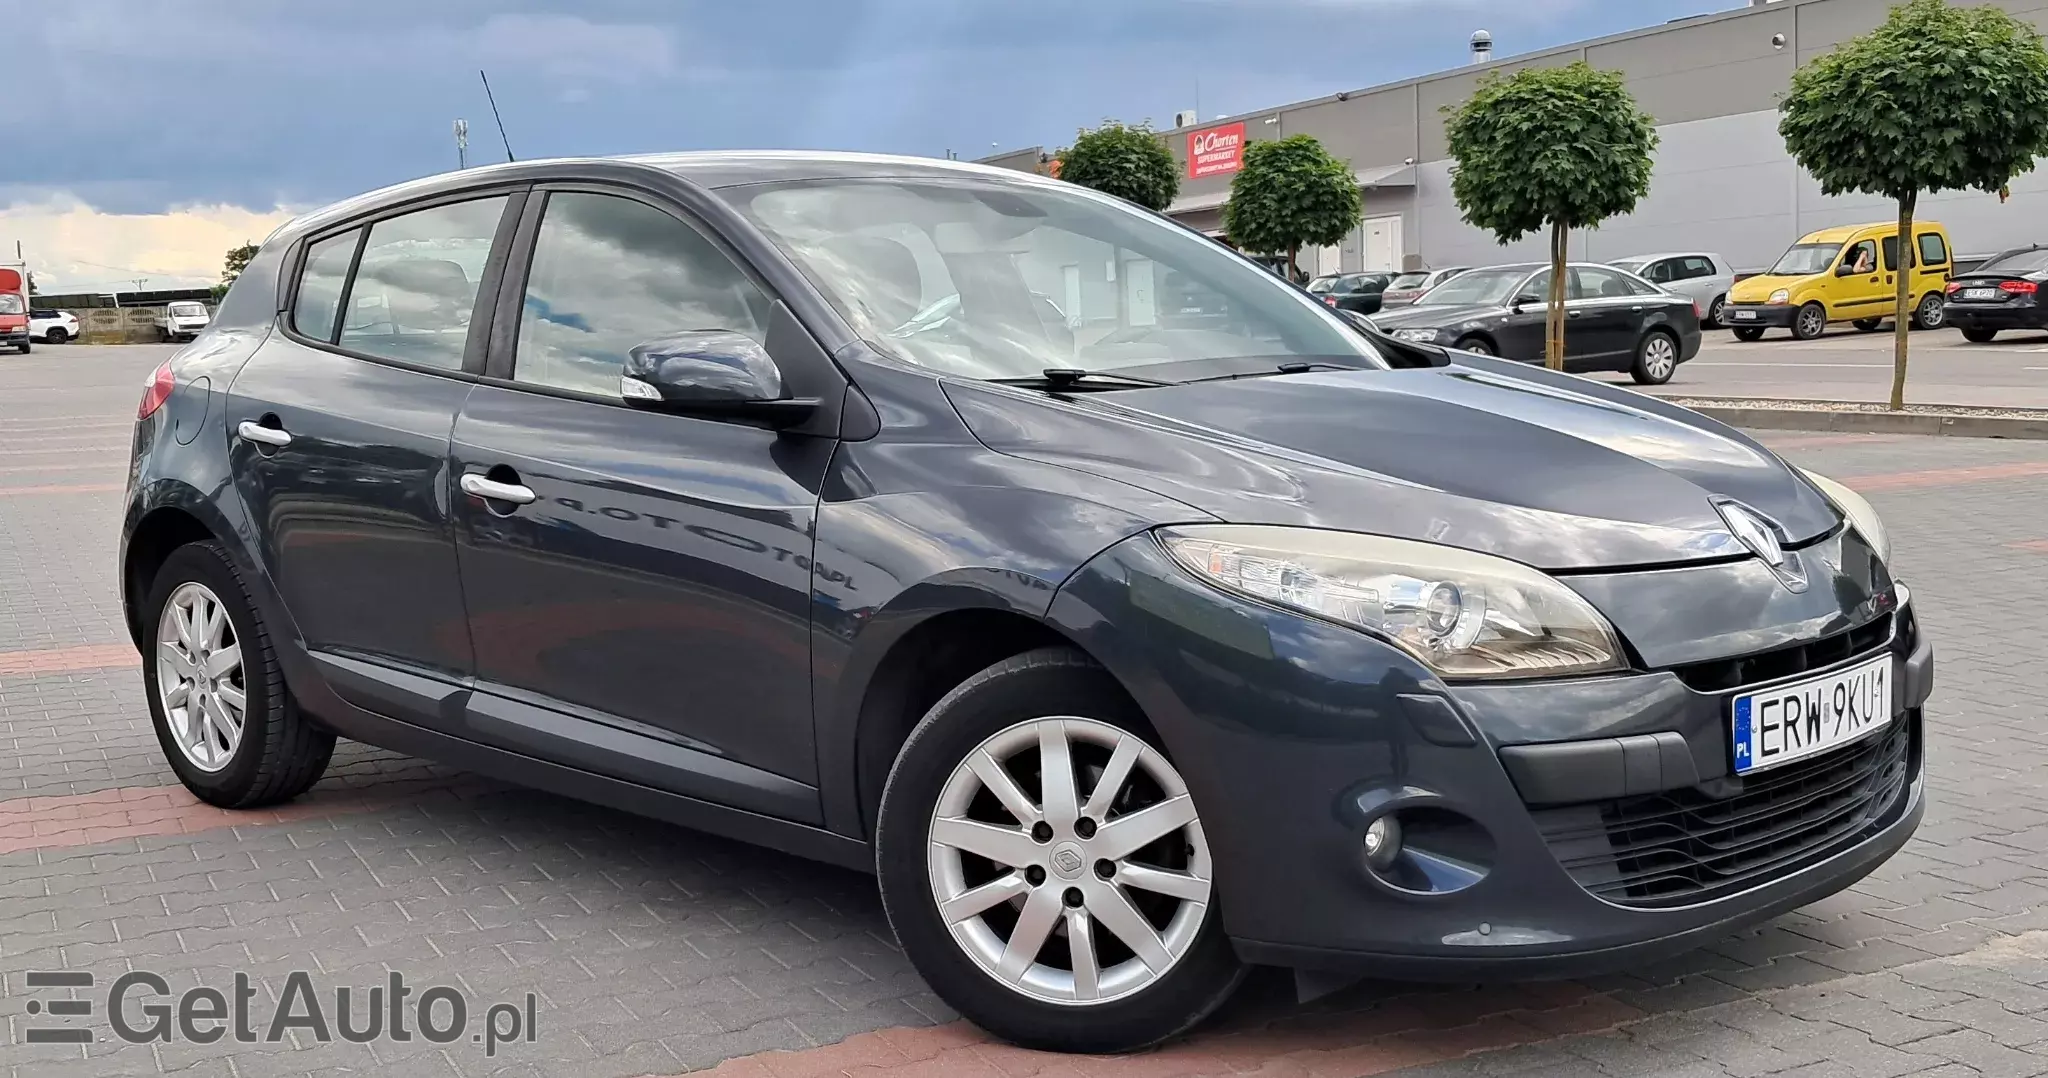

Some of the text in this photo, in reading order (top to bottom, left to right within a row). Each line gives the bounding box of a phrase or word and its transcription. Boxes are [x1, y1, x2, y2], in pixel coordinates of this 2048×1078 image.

[1197, 150, 1236, 165] SUPERMARKET
[1760, 666, 1884, 758] ERW 9KU1
[1736, 741, 1750, 759] PL
